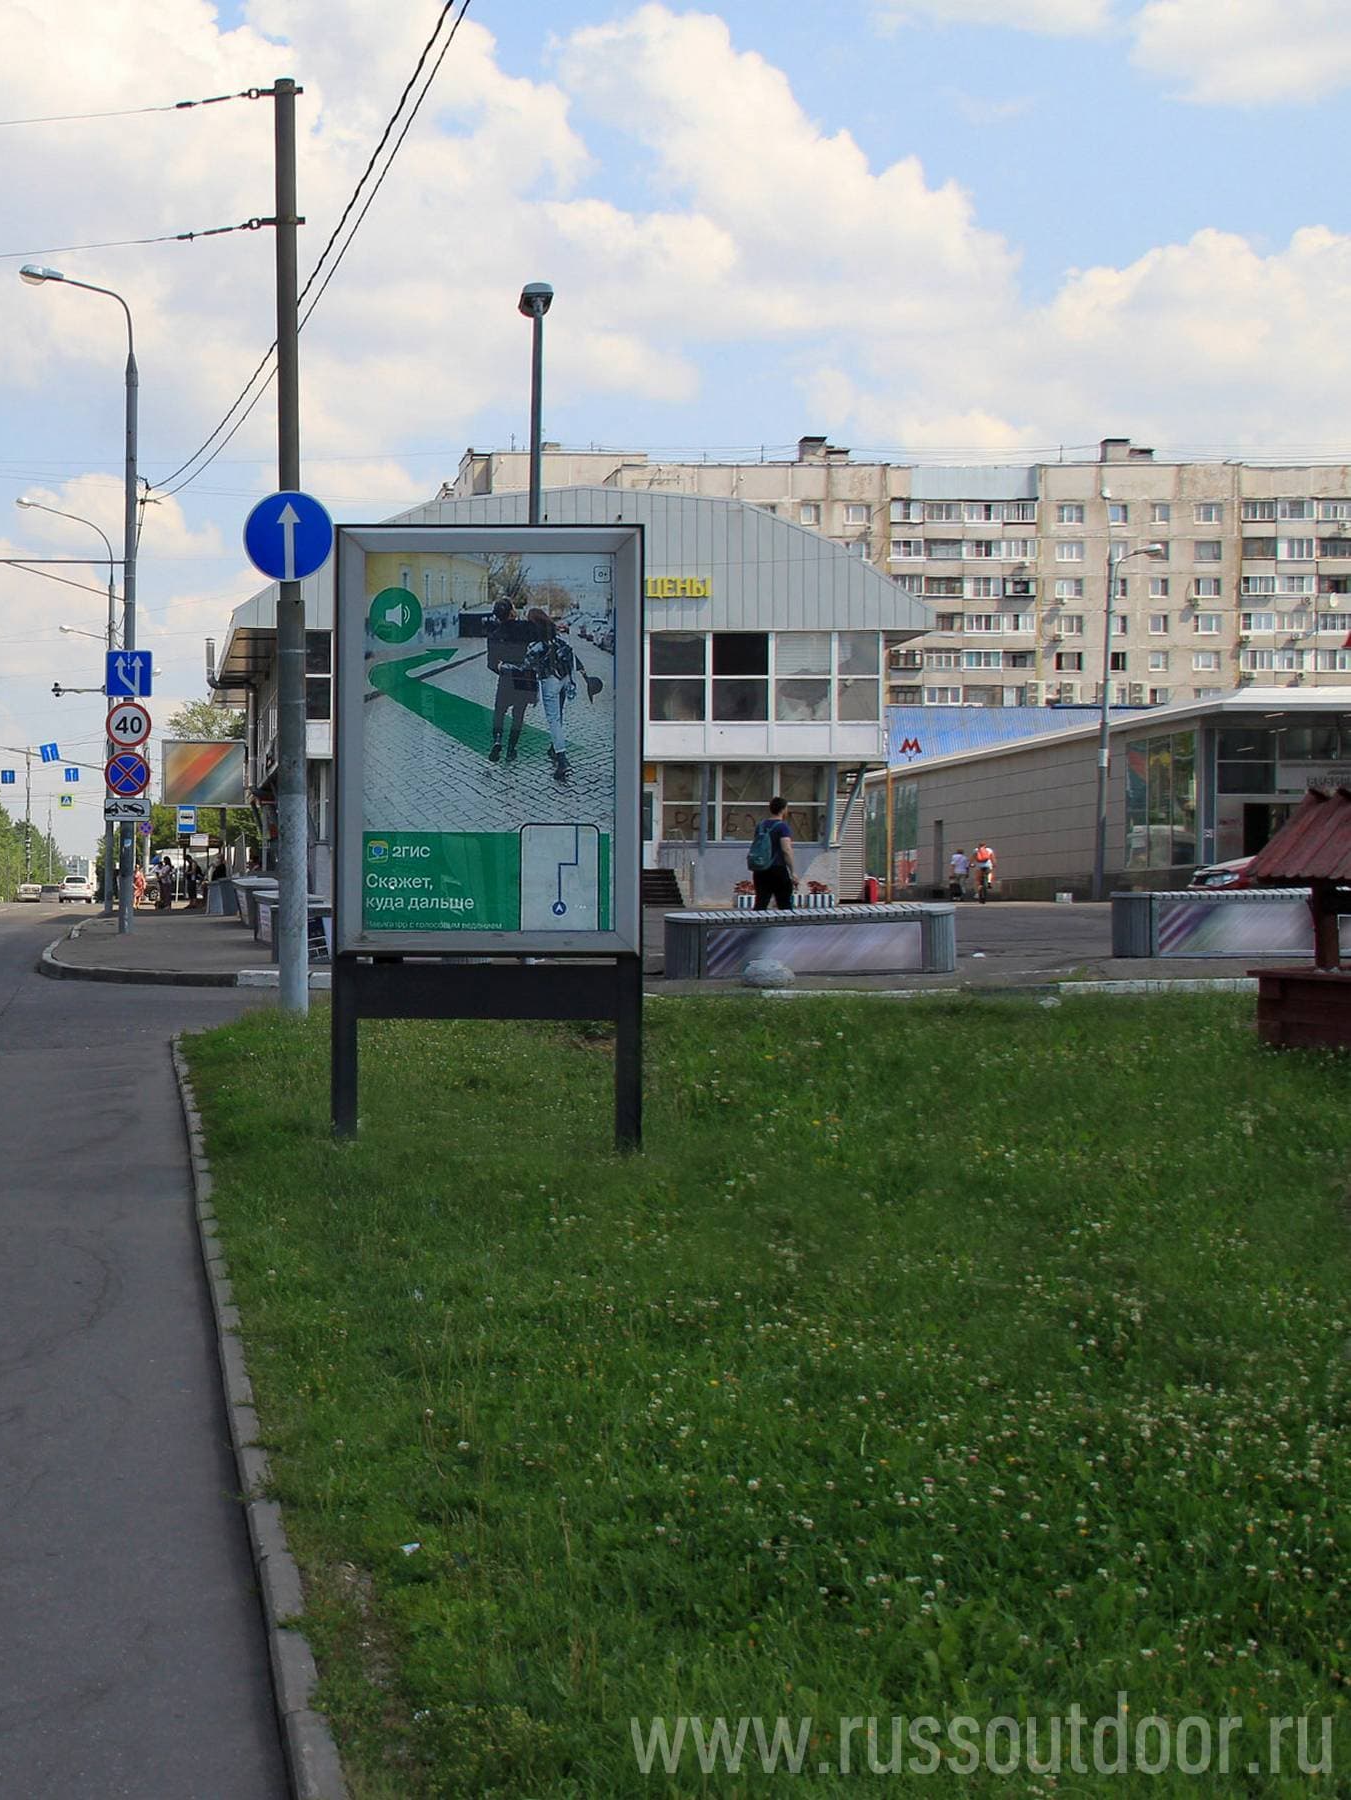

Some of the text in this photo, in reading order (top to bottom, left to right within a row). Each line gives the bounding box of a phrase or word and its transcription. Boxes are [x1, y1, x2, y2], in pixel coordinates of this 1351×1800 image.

[646, 576, 712, 599] ЦЕНЫ
[115, 716, 143, 735] 40
[392, 846, 431, 858] 2ГИС
[366, 873, 434, 890] Скажет,
[366, 896, 475, 911] куда дальше
